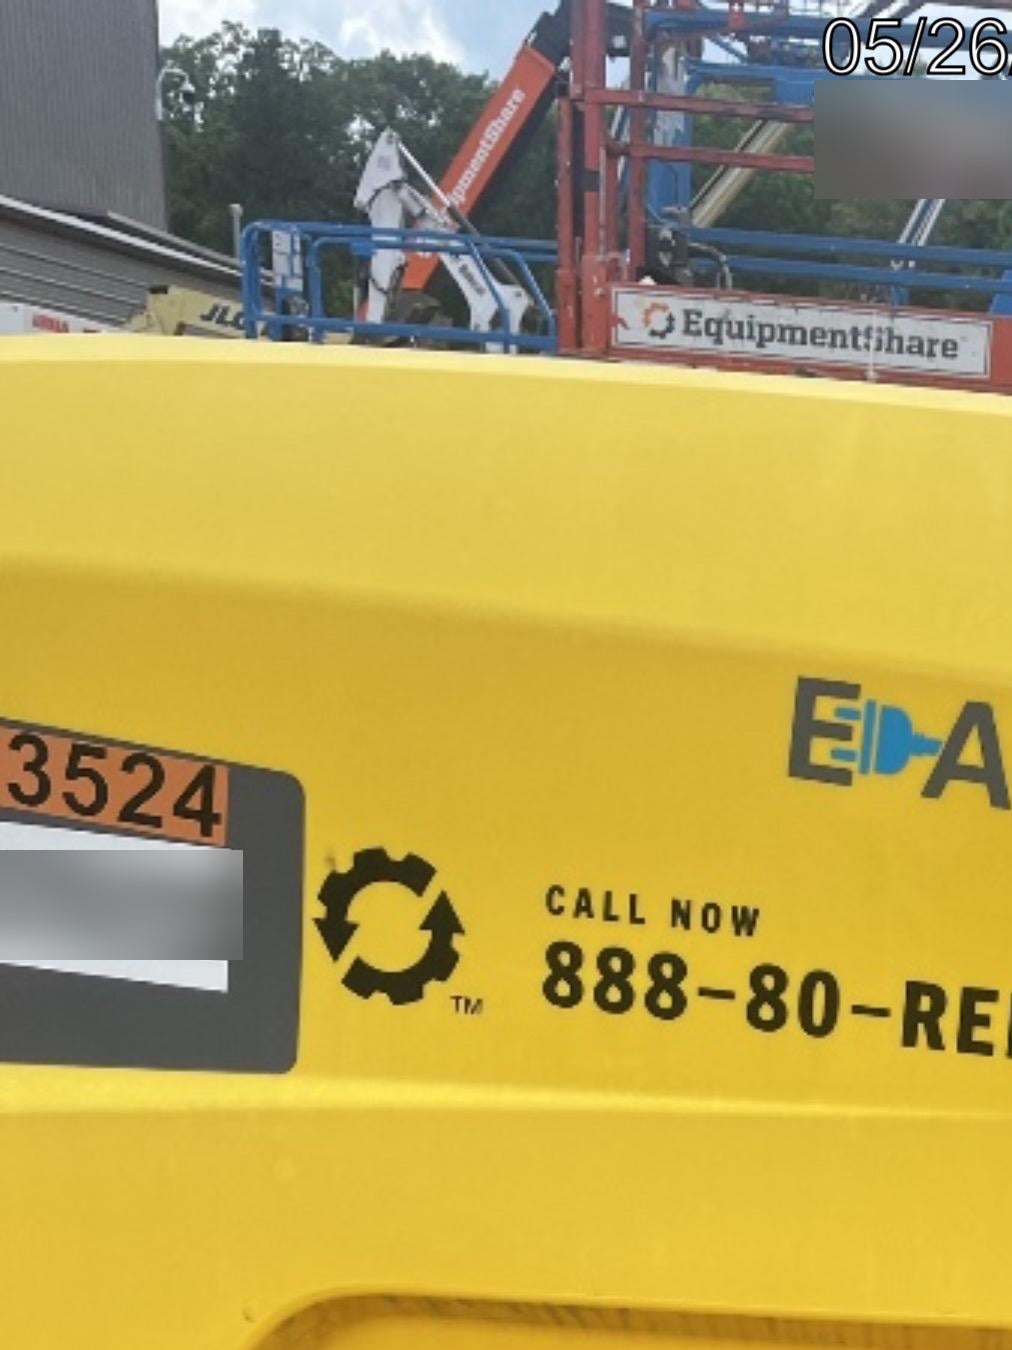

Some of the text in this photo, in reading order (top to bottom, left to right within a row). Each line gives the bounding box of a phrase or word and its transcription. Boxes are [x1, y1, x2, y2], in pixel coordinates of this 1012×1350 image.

[682, 307, 959, 360] EquipmentShare
[7, 731, 223, 838] 3524
[545, 883, 760, 938] CALL NOW
[450, 995, 483, 1016] TM
